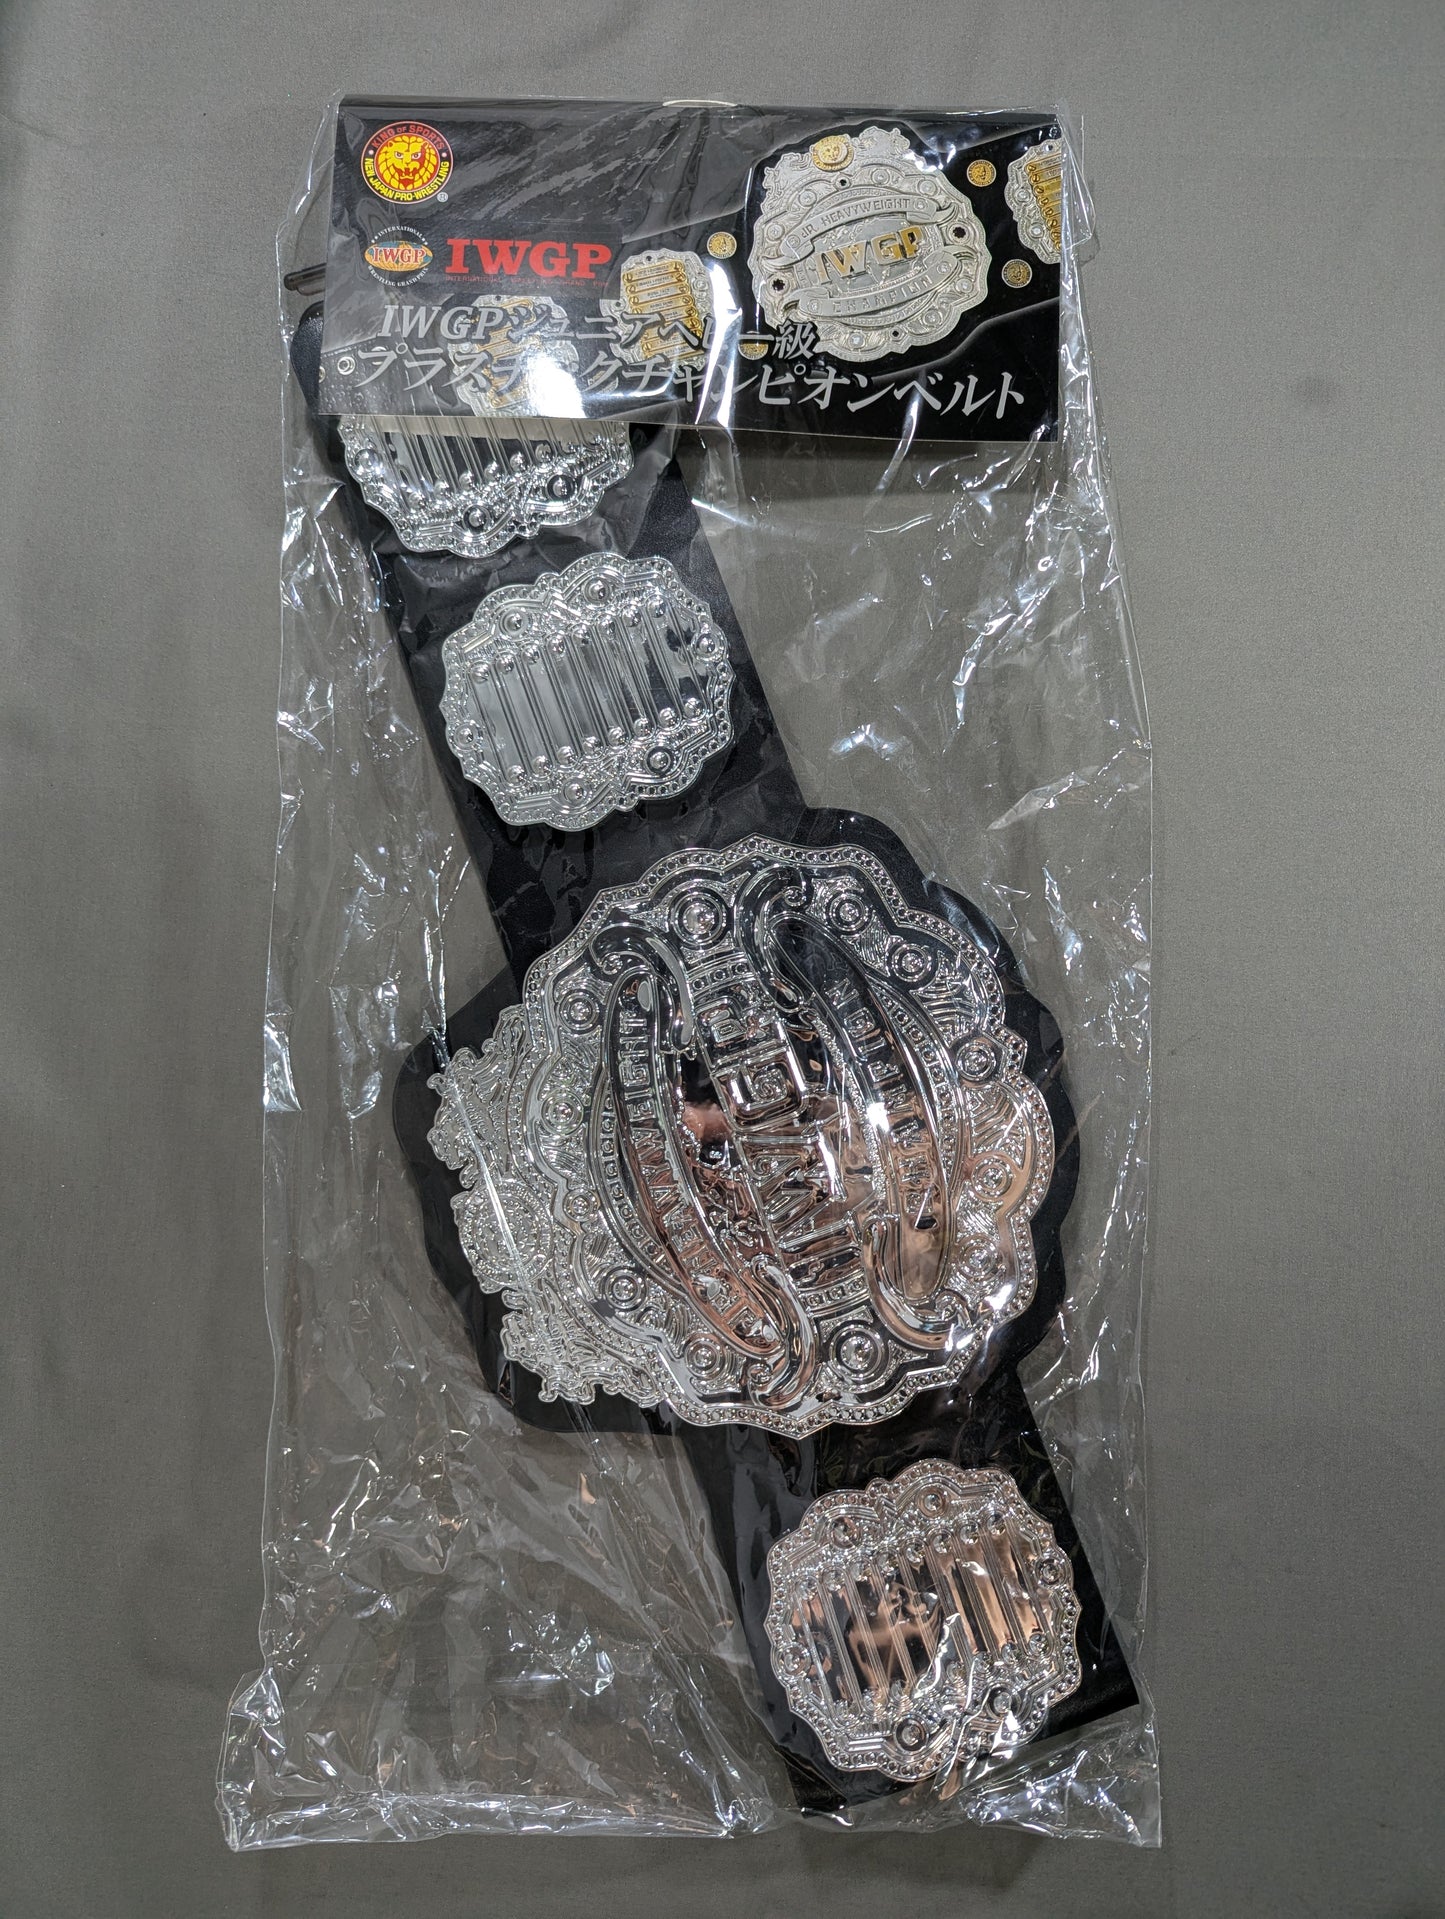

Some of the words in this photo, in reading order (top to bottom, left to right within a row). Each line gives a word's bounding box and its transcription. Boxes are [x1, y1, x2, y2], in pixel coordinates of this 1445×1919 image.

[371, 128, 395, 149] KING
[408, 124, 445, 150] SPORTS
[364, 157, 374, 177] NEW
[369, 175, 396, 199] JAPAN
[394, 161, 450, 201] PRO-WRESTLING
[821, 198, 910, 226] HEAVYWEIGHT
[377, 225, 423, 238] INTERNATIONAL
[372, 246, 426, 265] IWGP
[445, 238, 612, 278] IWGP
[814, 226, 923, 285] IWGP
[367, 265, 396, 287] WRESTLING
[354, 342, 1024, 419] プラスチクチャンピオンベルト
